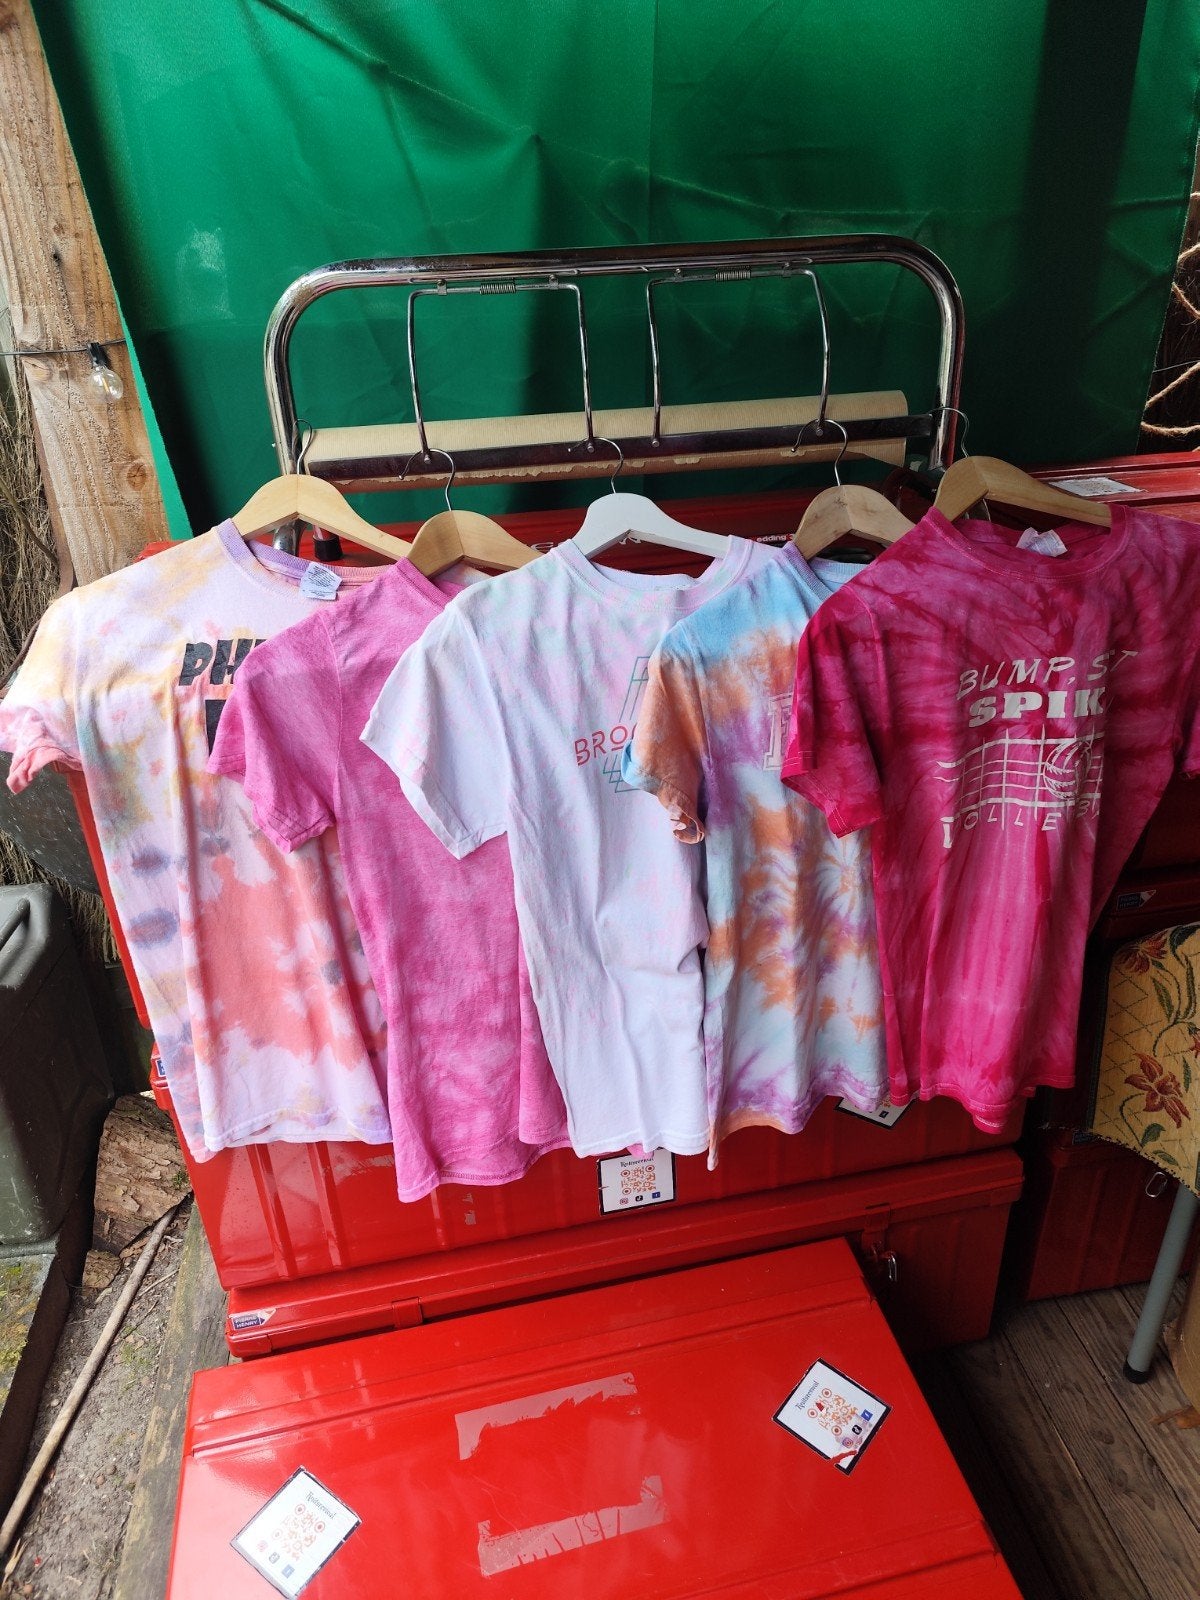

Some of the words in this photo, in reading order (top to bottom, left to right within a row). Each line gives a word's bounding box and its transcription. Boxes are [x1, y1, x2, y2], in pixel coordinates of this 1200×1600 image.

[179, 638, 268, 686] PH
[957, 656, 1075, 700] BUMP,
[968, 686, 1108, 728] SPIK
[574, 723, 637, 766] BRO
[236, 1320, 258, 1328] HENRY
